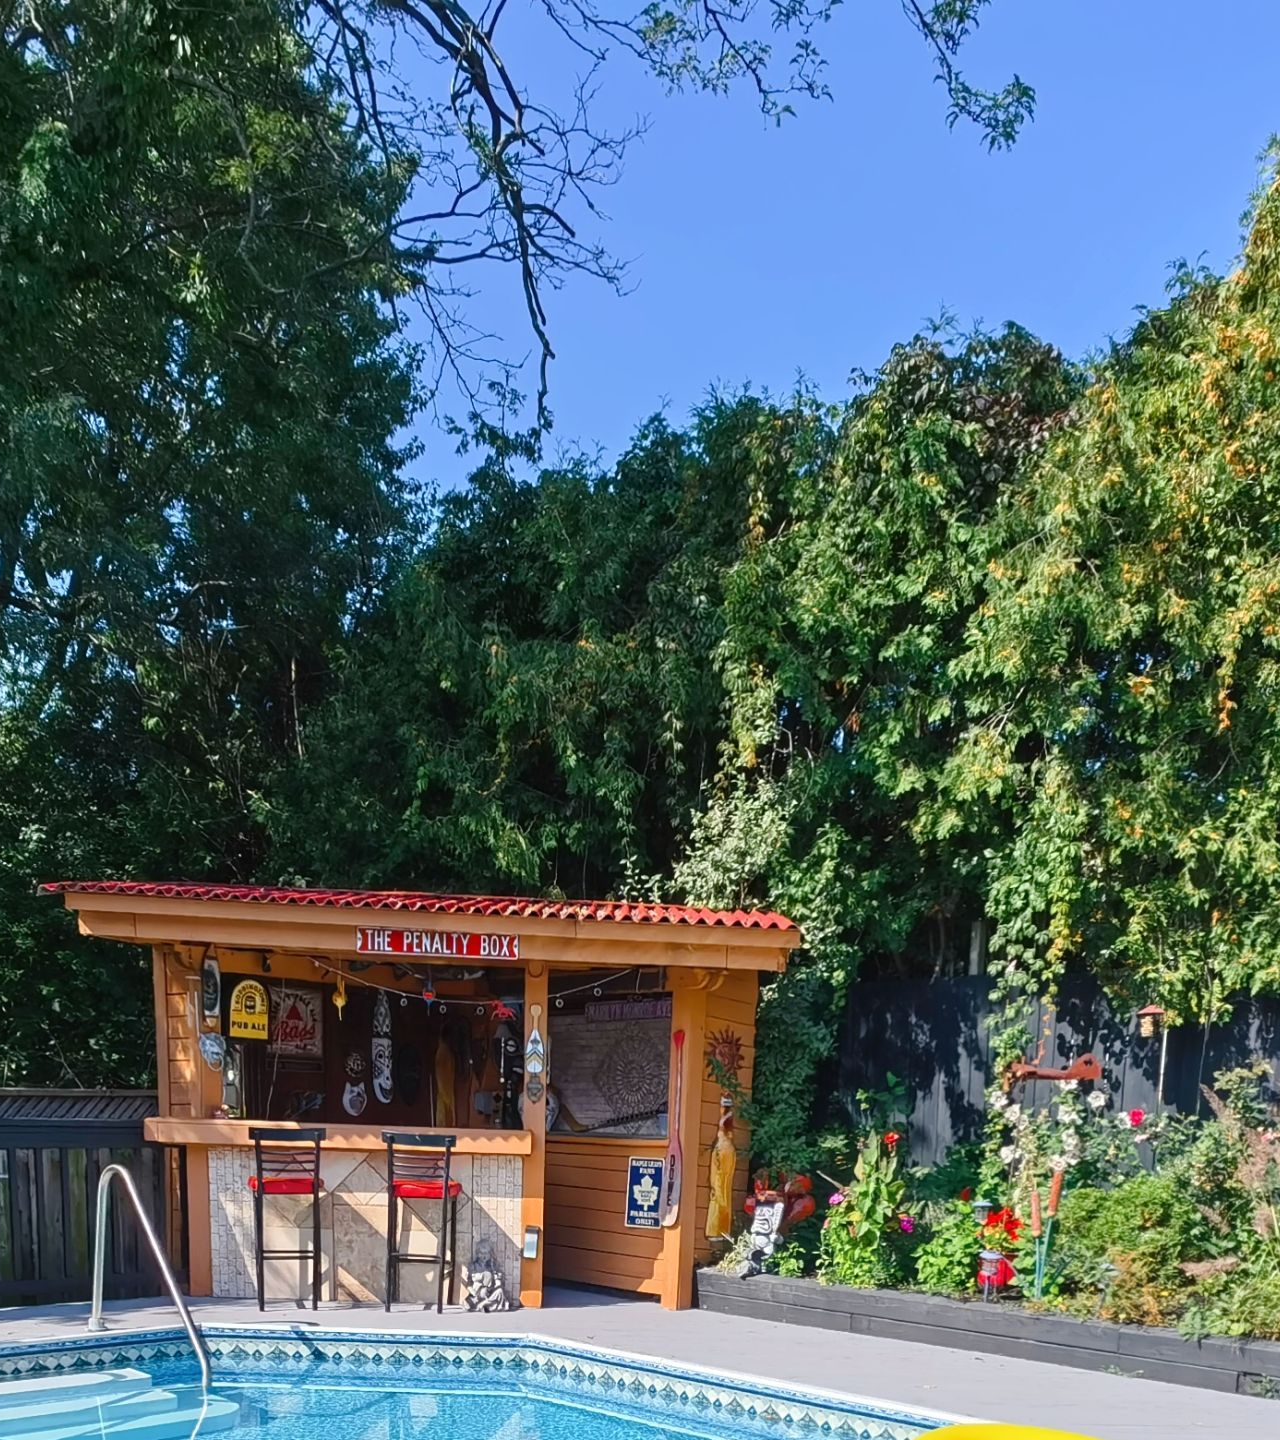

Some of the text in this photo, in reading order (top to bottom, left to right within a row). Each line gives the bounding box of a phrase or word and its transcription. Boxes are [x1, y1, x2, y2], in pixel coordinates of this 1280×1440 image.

[365, 929, 510, 957] THE PENALTY BOX
[231, 1020, 266, 1032] PUB ALE
